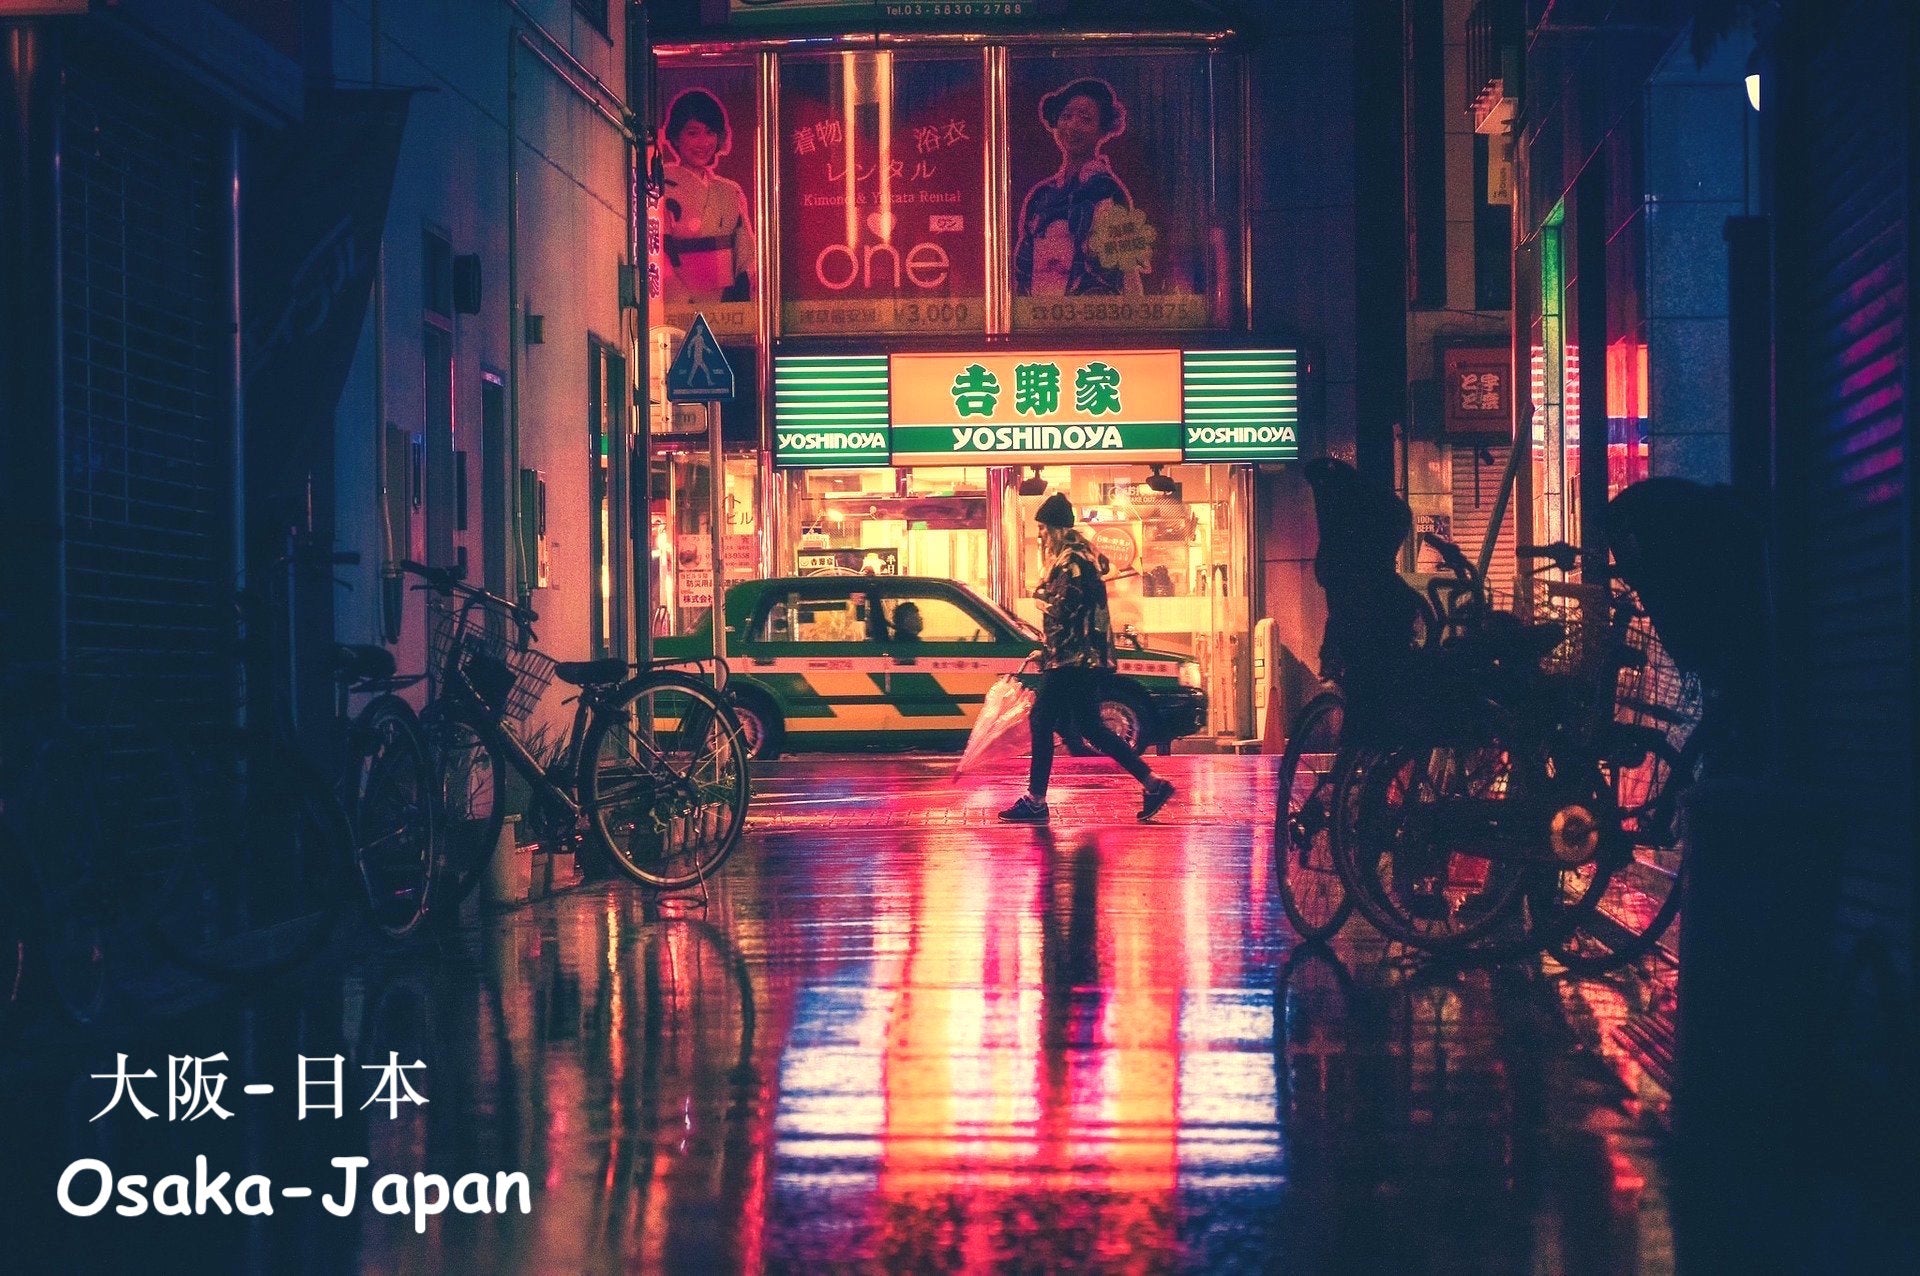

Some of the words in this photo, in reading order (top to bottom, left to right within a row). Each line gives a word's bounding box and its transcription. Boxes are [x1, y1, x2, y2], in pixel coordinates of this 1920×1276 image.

[794, 119, 842, 155] 着物
[914, 118, 970, 153] 浴衣
[826, 159, 936, 182] レンタル
[872, 191, 915, 203] Ykata
[919, 190, 962, 203] Rental
[815, 242, 950, 290] one
[952, 362, 1122, 417] 吉野家
[777, 432, 886, 450] YOSHINOYA
[952, 425, 1123, 451] YOSHINOYA
[1187, 426, 1296, 444] YOSHINOYA
[727, 511, 754, 525] ビル
